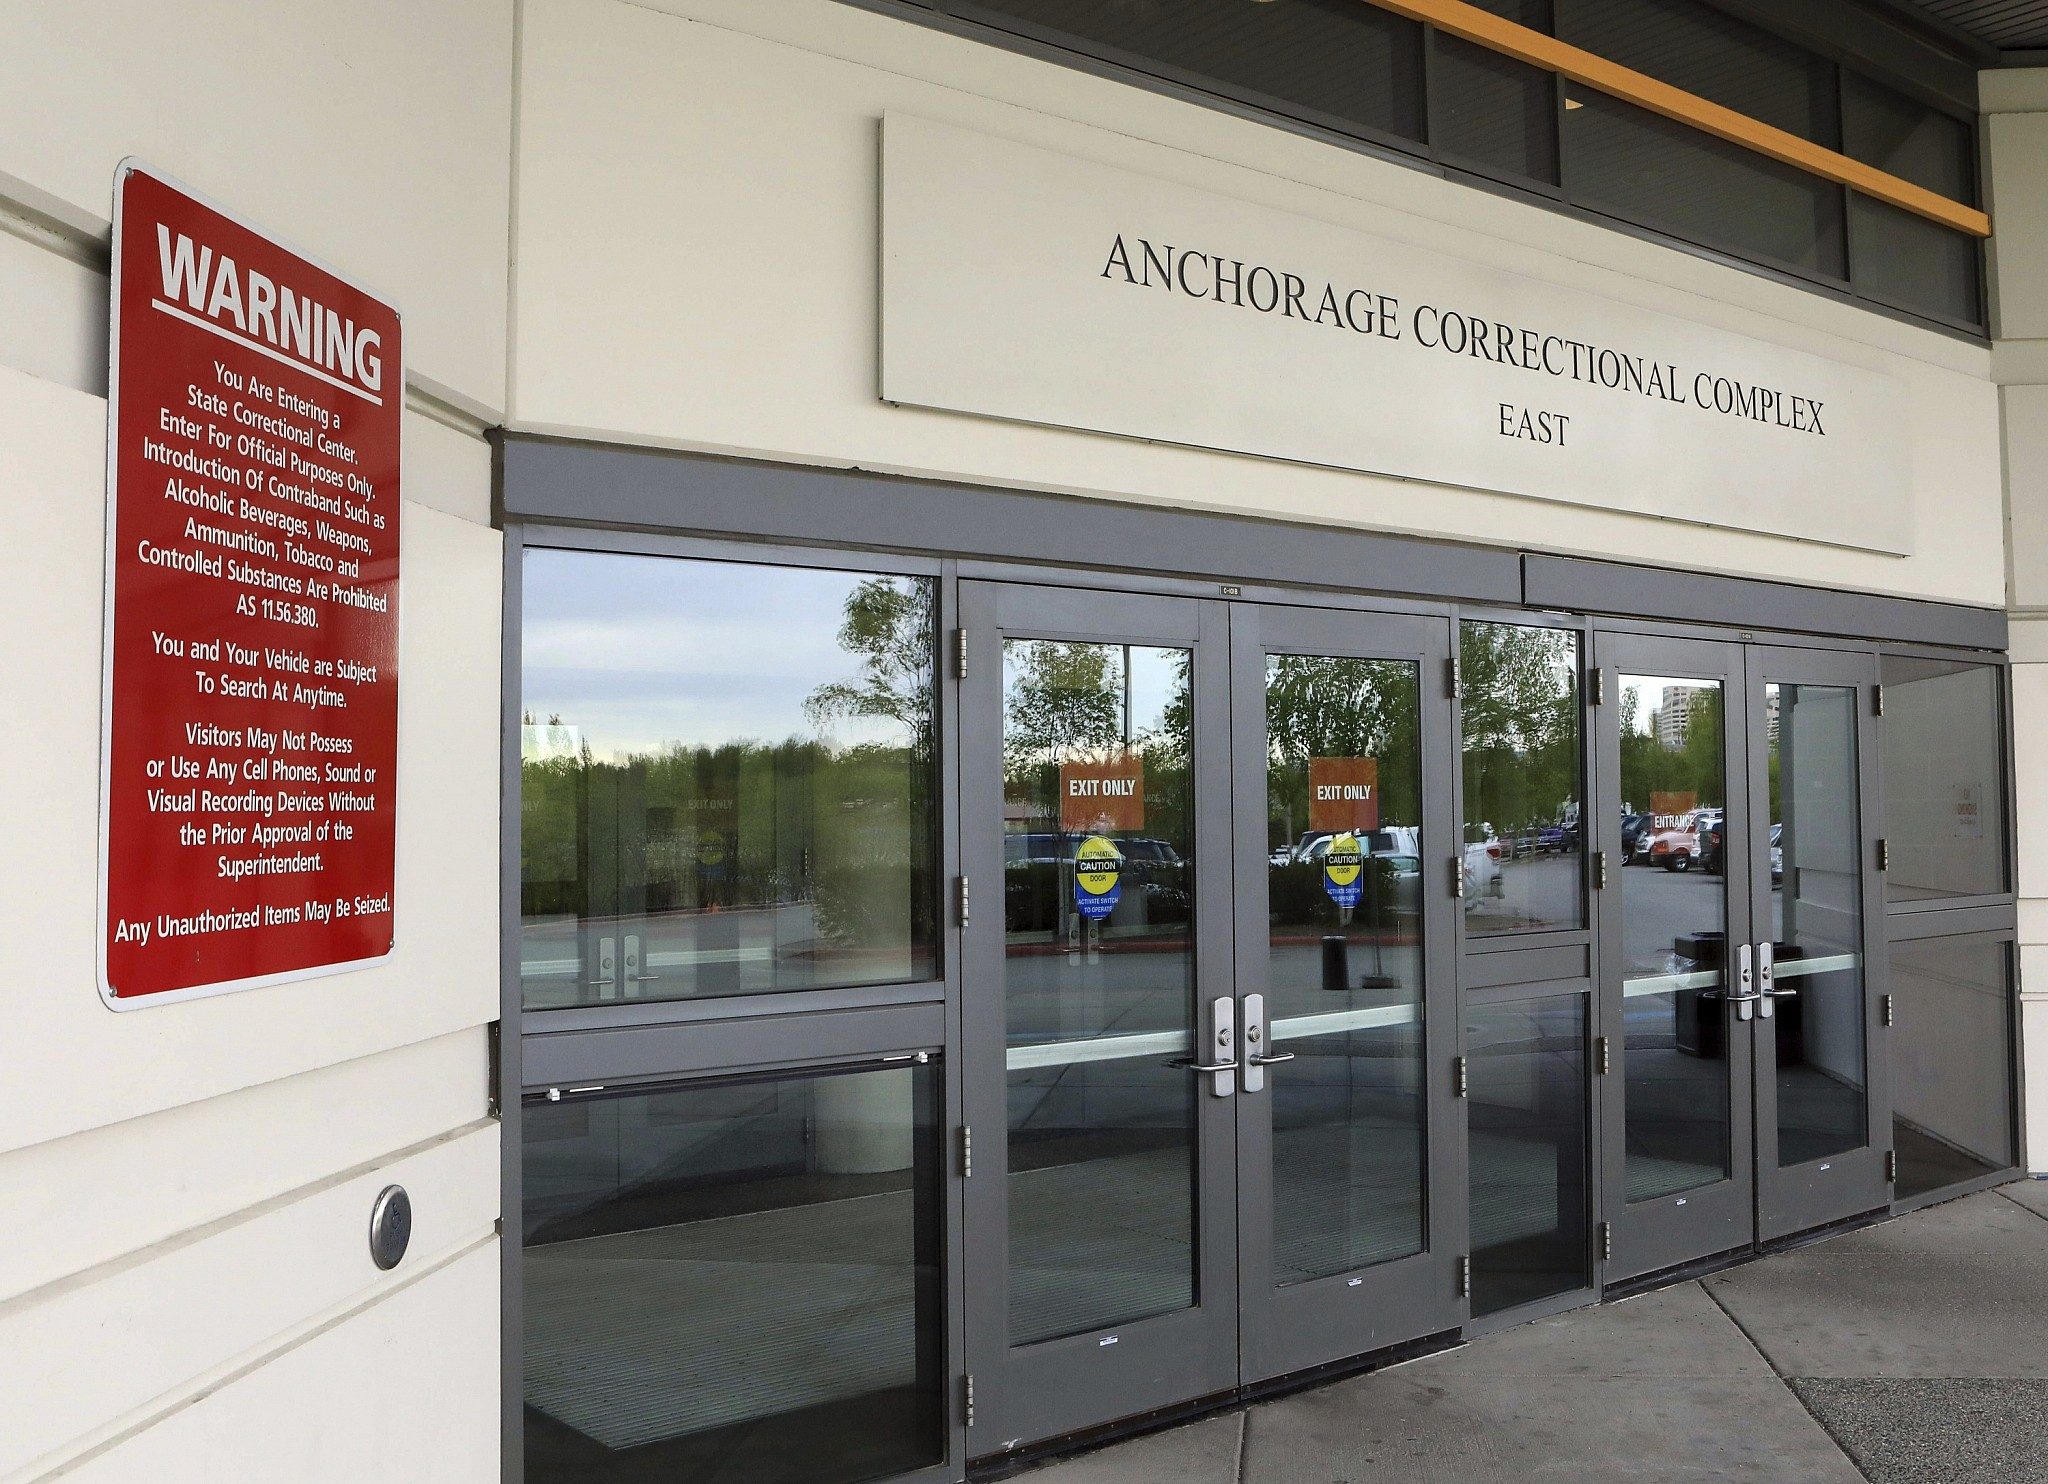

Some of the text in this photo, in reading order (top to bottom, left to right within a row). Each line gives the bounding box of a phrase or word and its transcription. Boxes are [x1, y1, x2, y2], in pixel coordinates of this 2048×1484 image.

[156, 222, 382, 390] WARNING
[1101, 233, 1827, 436] ANCHORAGE CORRECTIONAL COMPLEX
[213, 360, 339, 429] You Are Entering a
[188, 384, 357, 464] State Correctional Center.
[1498, 402, 1571, 447] EAST
[160, 407, 375, 501] Enter For Official Purposes Only.
[144, 436, 384, 529] Introduction Of Contraband Such as
[164, 477, 371, 555] Alcoholic Beverages, Weapons,
[184, 516, 358, 578] Ammunition, Tobacco and
[138, 539, 387, 612] Controlled Substances Are Prohibited
[235, 593, 318, 628] AS 11.56.380.
[151, 630, 376, 685] You and Your Vehicle are Subject
[195, 670, 346, 708] To Search At Anytime.
[185, 721, 352, 754] Visitors May Not Possess
[146, 755, 376, 785] or Use Any Cell Phones, Sound or
[147, 788, 374, 816] Visual Recording Devices Without
[688, 799, 733, 810] EXIT ONLY
[1069, 779, 1136, 796] EXIT ONLY
[1317, 785, 1371, 801] EXIT ONLY
[179, 819, 352, 848] the Prior Approval of the
[1654, 814, 1695, 828] ENTRANCE
[217, 850, 323, 881] Superintendent.
[1080, 861, 1116, 871] CAUTION
[1081, 850, 1113, 858] AUTOMATIC
[1328, 855, 1358, 864] CAUTION
[1089, 874, 1107, 882] DOOR
[1078, 897, 1099, 905] ACTIVATE
[114, 891, 390, 946] Any Unauthorized Items May Be Seized.
